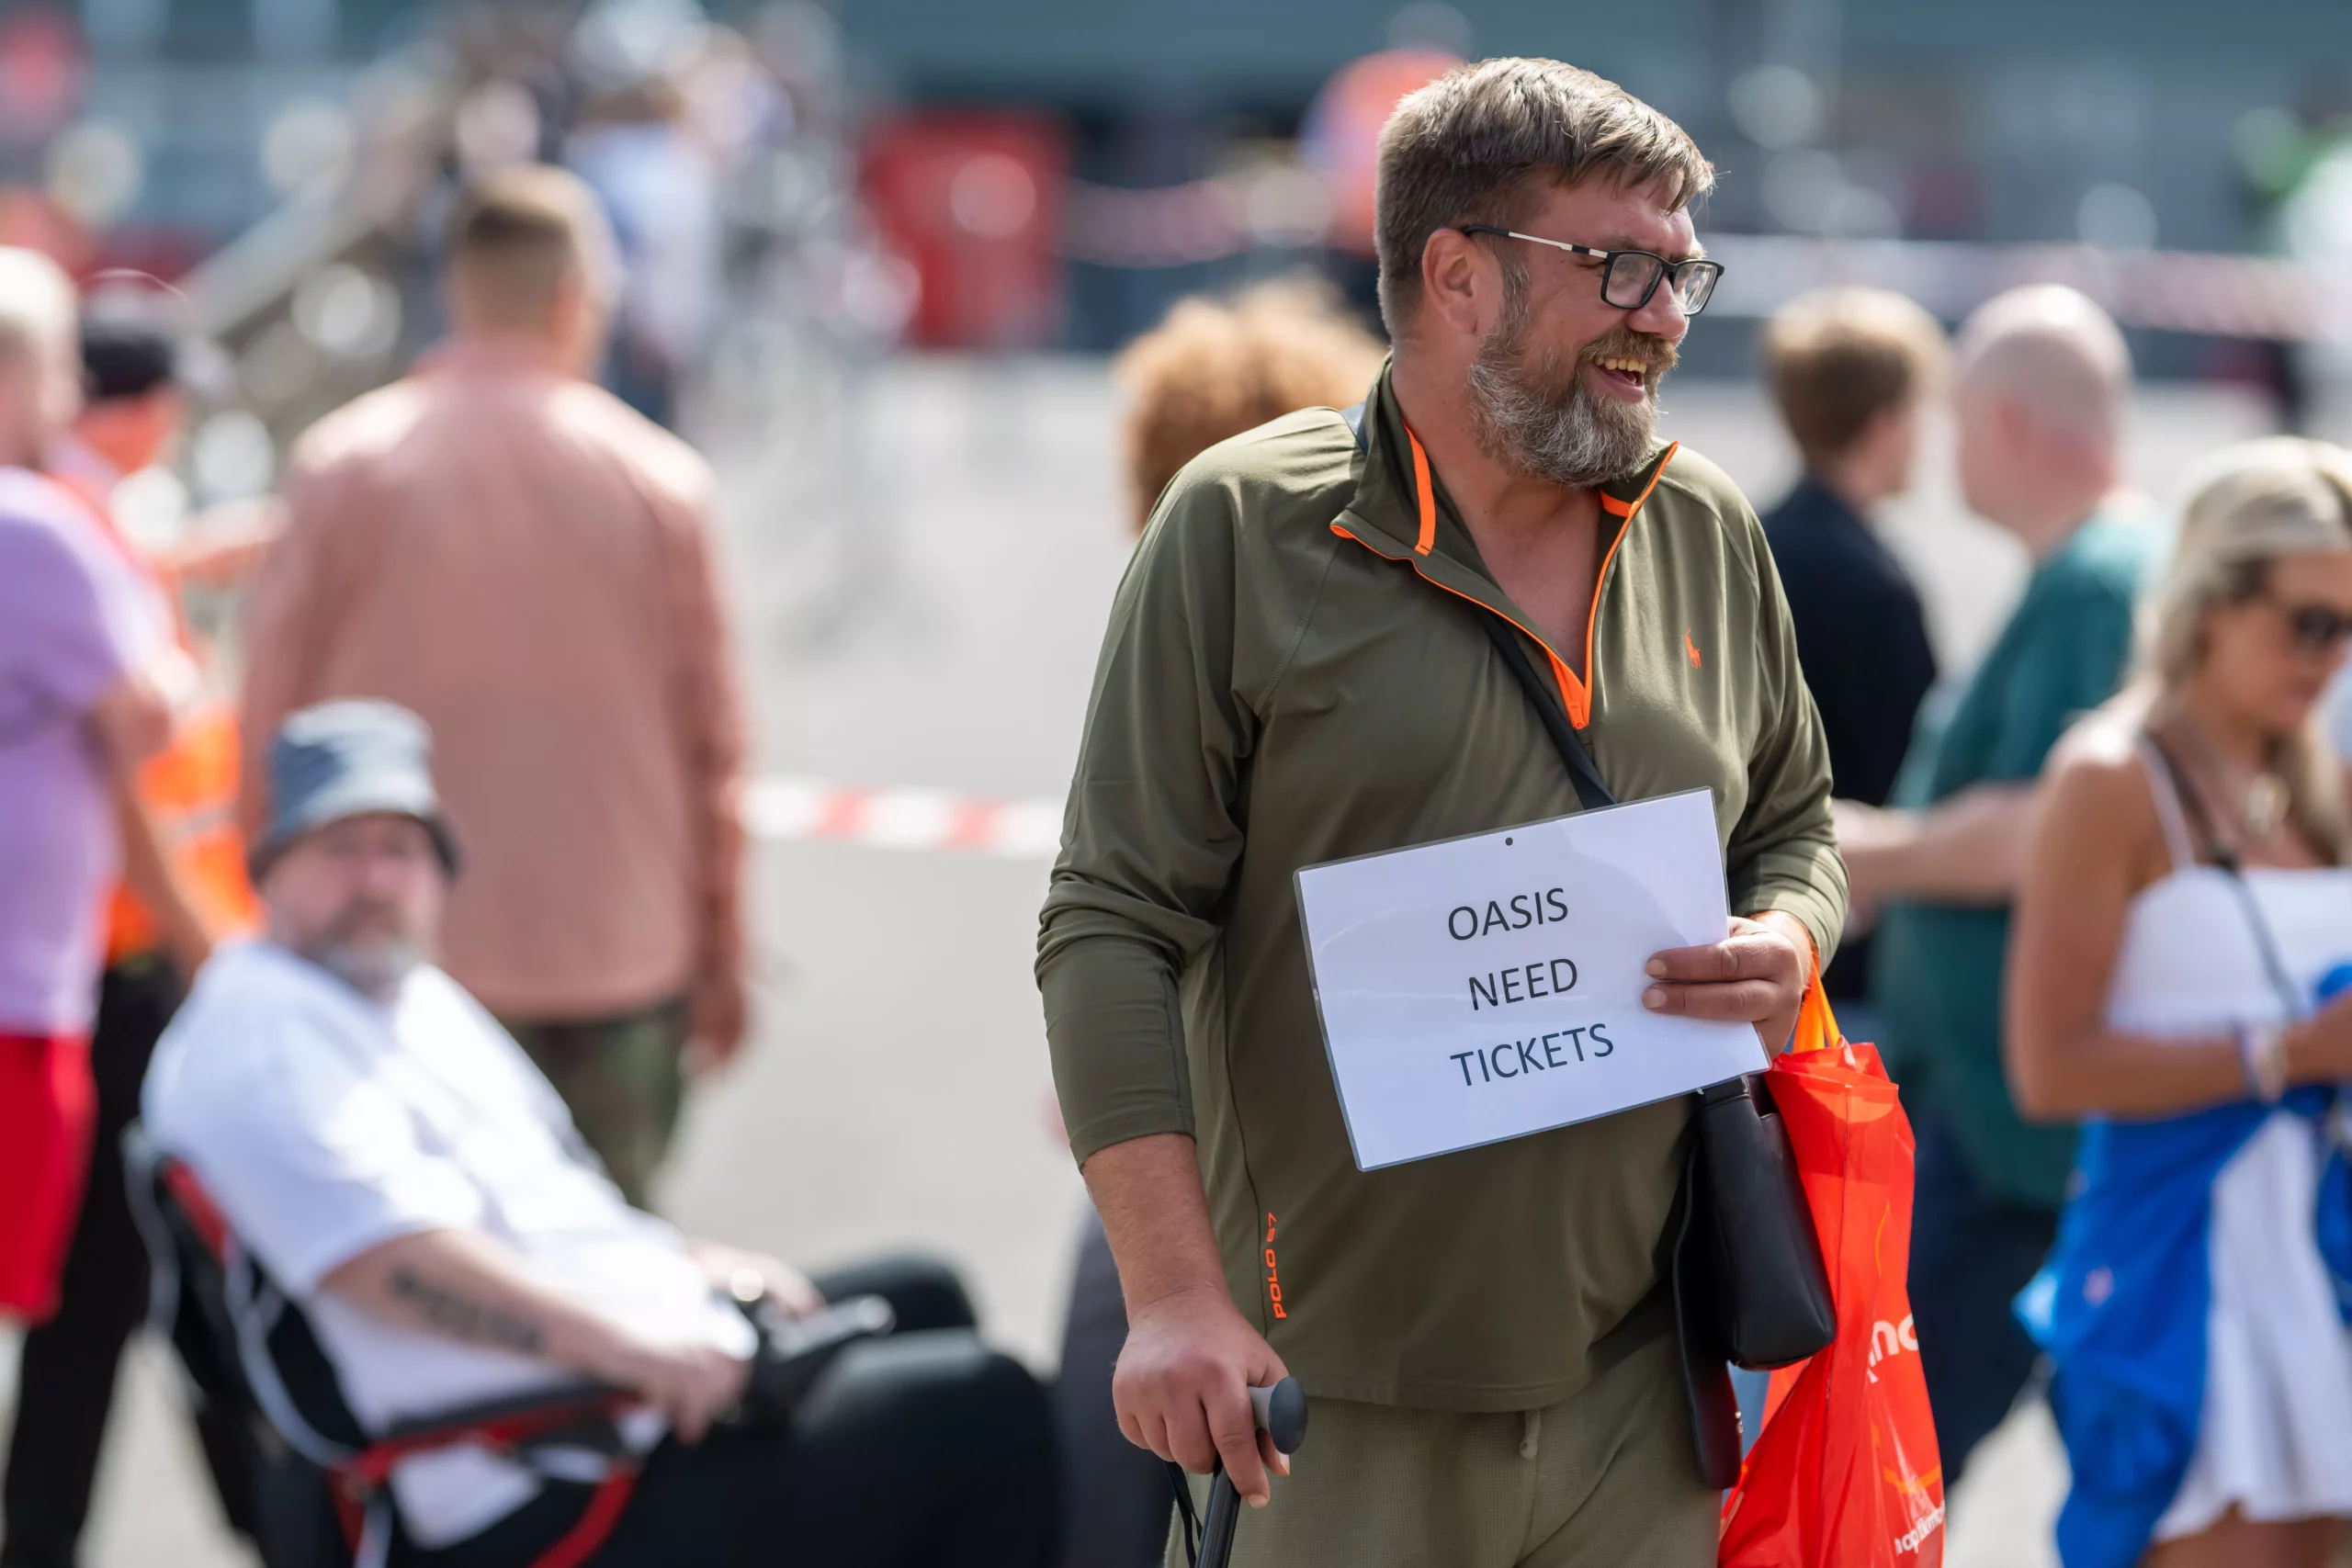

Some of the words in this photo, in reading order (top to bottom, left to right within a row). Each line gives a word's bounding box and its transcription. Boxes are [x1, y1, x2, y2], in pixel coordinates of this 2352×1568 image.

[1448, 887, 1568, 941] OASIS
[1468, 958, 1578, 1011] NEED
[1450, 1023, 1614, 1087] TICKETS
[1265, 1248, 1287, 1319] POLO
